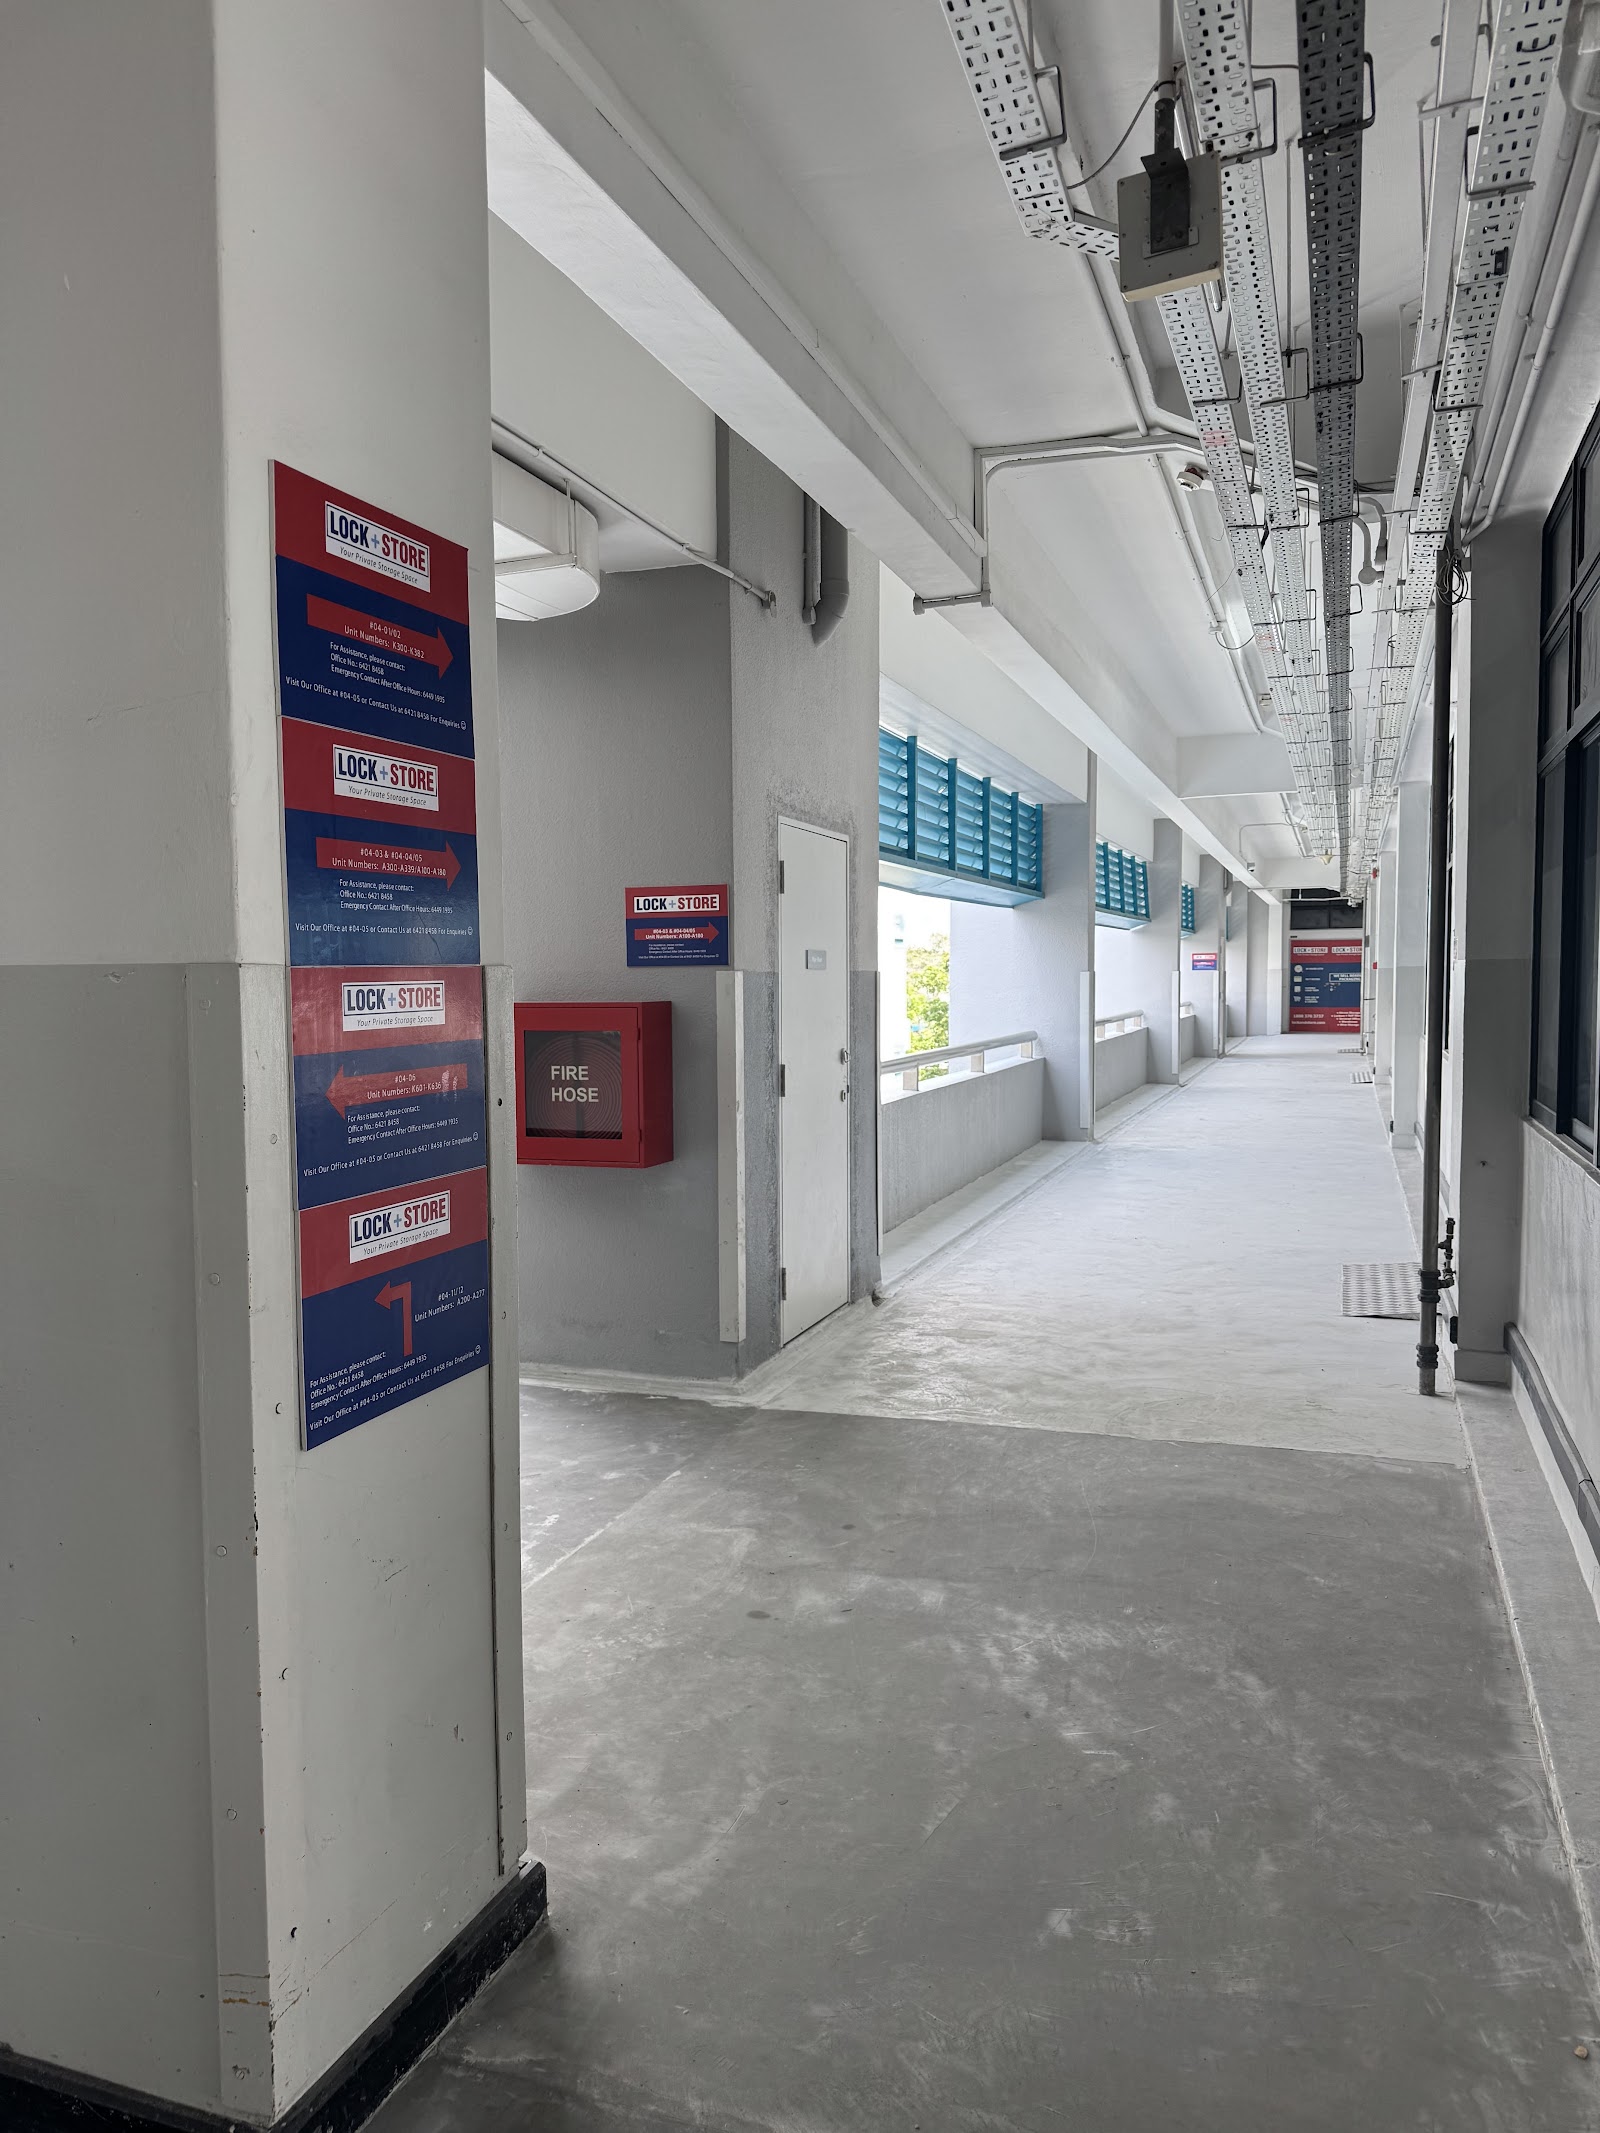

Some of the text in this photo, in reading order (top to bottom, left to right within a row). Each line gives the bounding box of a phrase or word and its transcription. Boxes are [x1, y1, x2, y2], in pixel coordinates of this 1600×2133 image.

[340, 546, 418, 585] Your Private Storage Space
[369, 621, 401, 639] #04-01/02
[344, 624, 425, 659] Unit Numbers: K300-K382
[330, 641, 340, 651] For
[339, 644, 369, 661] Assistance,
[368, 654, 386, 666] please
[330, 652, 347, 665] Office
[330, 663, 360, 681] Emergency
[359, 672, 381, 686] Contact
[380, 678, 393, 688] After
[392, 681, 407, 693] Office
[285, 675, 300, 687] Visit
[300, 679, 313, 690] Our
[313, 683, 332, 696] Office
[332, 689, 339, 698] at
[360, 697, 368, 705] or
[368, 697, 390, 711] Contact
[389, 703, 398, 713] Us
[429, 714, 439, 723] For
[348, 785, 427, 806] Your Private Storage Space
[360, 847, 384, 858] #04-03
[384, 850, 389, 859] &
[332, 857, 347, 868] Unit
[347, 858, 379, 870] Numbers:
[339, 878, 349, 887] For
[348, 879, 378, 890] Assistance,
[378, 881, 395, 891] please
[339, 889, 357, 899] Office
[340, 900, 369, 912] Emergency
[368, 902, 390, 911] Contact
[389, 903, 401, 912] After
[400, 904, 416, 912] Office
[295, 922, 309, 932] Visit
[310, 923, 322, 932] Our
[322, 923, 341, 932] Office
[341, 925, 348, 933] at
[376, 925, 398, 934] Contact
[398, 926, 406, 934] Us
[437, 927, 446, 935] For
[356, 1015, 434, 1027] Your Private Storage Space
[551, 1066, 589, 1080] FIRE
[366, 1089, 381, 1100] Unit
[381, 1086, 411, 1097] Numbers:
[551, 1087, 599, 1103] HOSE
[347, 1115, 357, 1123] For
[356, 1111, 385, 1122] Assistance,
[385, 1108, 402, 1118] please
[347, 1124, 364, 1134] Office
[347, 1134, 376, 1145] Emergency
[375, 1129, 396, 1139] Contact
[395, 1127, 407, 1136] After
[406, 1124, 422, 1133] Office
[303, 1167, 317, 1177] Visit
[317, 1165, 330, 1174] Our
[330, 1161, 348, 1172] Office
[348, 1160, 355, 1168] at
[376, 1154, 383, 1162] or
[383, 1150, 404, 1160] Contact
[404, 1148, 412, 1156] Us
[443, 1139, 452, 1147] For
[363, 1228, 439, 1256] Your Private Storage Space
[414, 1311, 427, 1323] Unit
[428, 1301, 455, 1317] Numbers:
[309, 1379, 319, 1389] For
[319, 1367, 349, 1385] Assistance,
[348, 1360, 366, 1374] please
[309, 1419, 323, 1431] Visit
[323, 1414, 335, 1425] Our
[335, 1406, 352, 1419] Office
[352, 1402, 359, 1411] at
[379, 1390, 386, 1399] or
[386, 1380, 407, 1395] Contact
[407, 1377, 414, 1386] Us
[414, 1374, 420, 1383] at
[445, 1360, 454, 1368] For
[310, 1393, 340, 1411] Emergency
[339, 1383, 360, 1398] Contact
[359, 1378, 373, 1389] After
[372, 1371, 388, 1383] Office
[310, 1387, 327, 1400] Office
